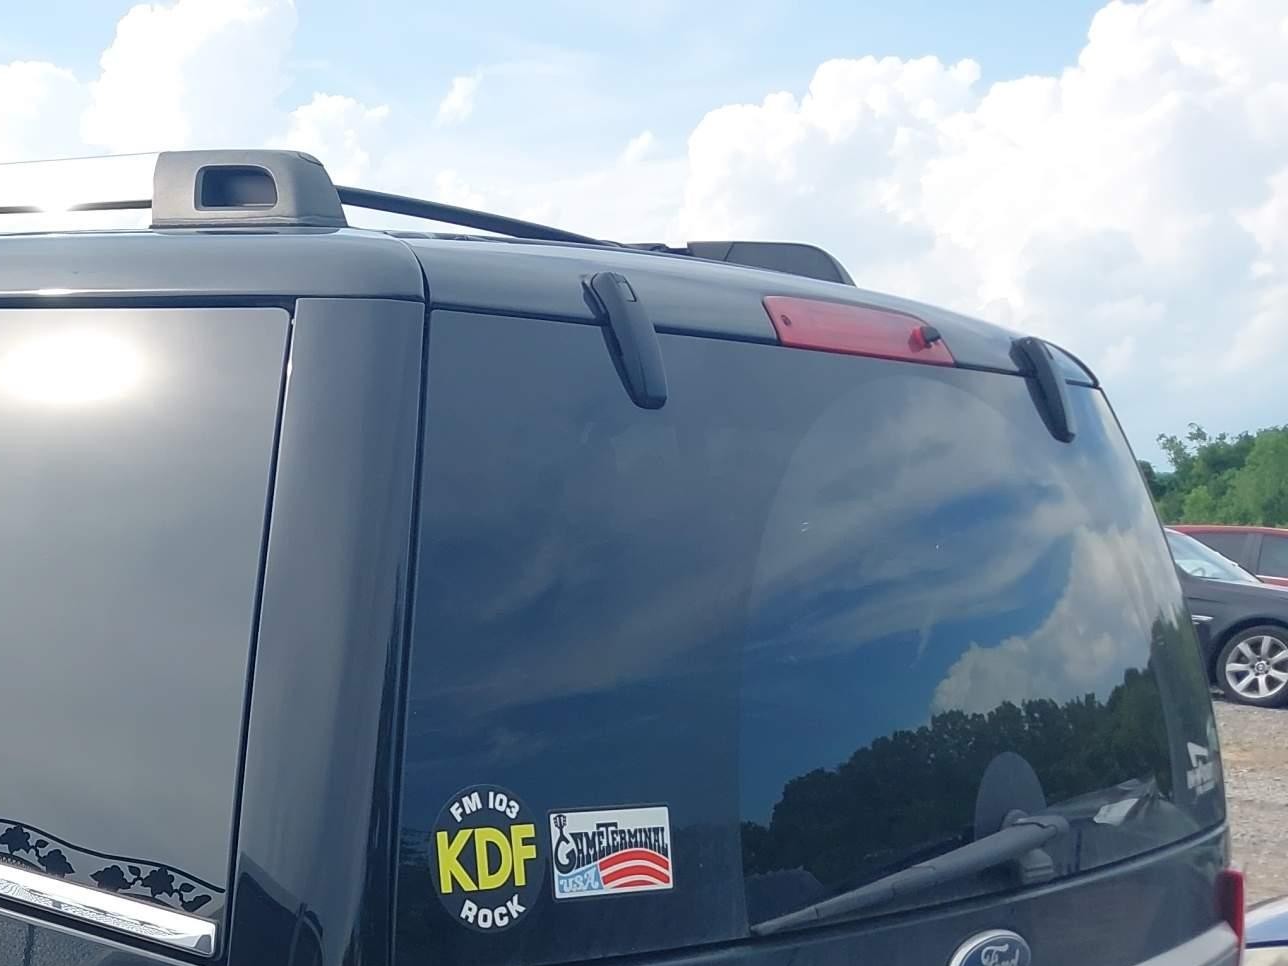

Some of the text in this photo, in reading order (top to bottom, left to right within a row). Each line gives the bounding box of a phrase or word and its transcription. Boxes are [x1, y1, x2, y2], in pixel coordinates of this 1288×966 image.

[449, 791, 520, 823] FM 103
[436, 823, 537, 894] KDF
[559, 866, 600, 893] USA
[460, 894, 526, 929] ROCK
